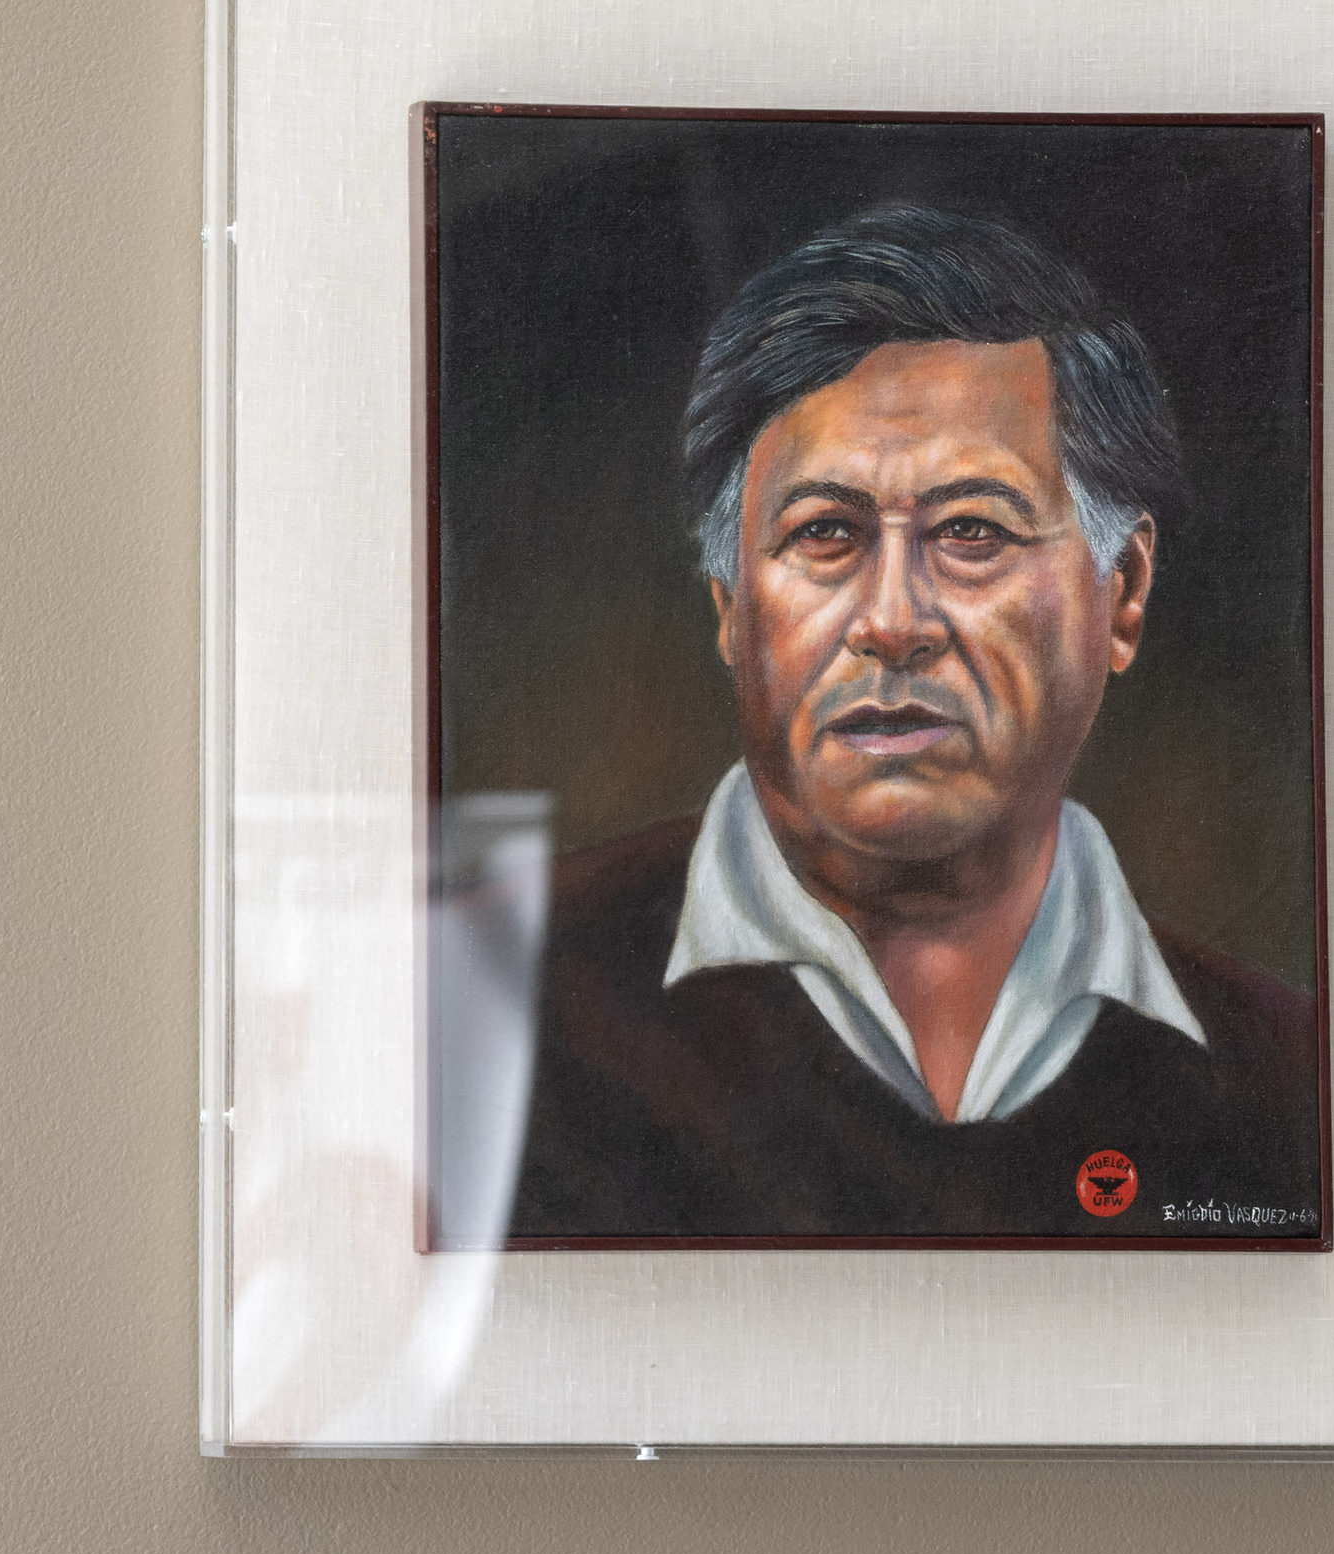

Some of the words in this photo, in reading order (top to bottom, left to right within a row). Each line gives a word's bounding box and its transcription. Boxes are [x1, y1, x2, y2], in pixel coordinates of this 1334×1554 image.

[1086, 1156, 1132, 1173] HUELGA
[1092, 1197, 1124, 1207] UFW
[1223, 1202, 1287, 1227] VASQUEZ
